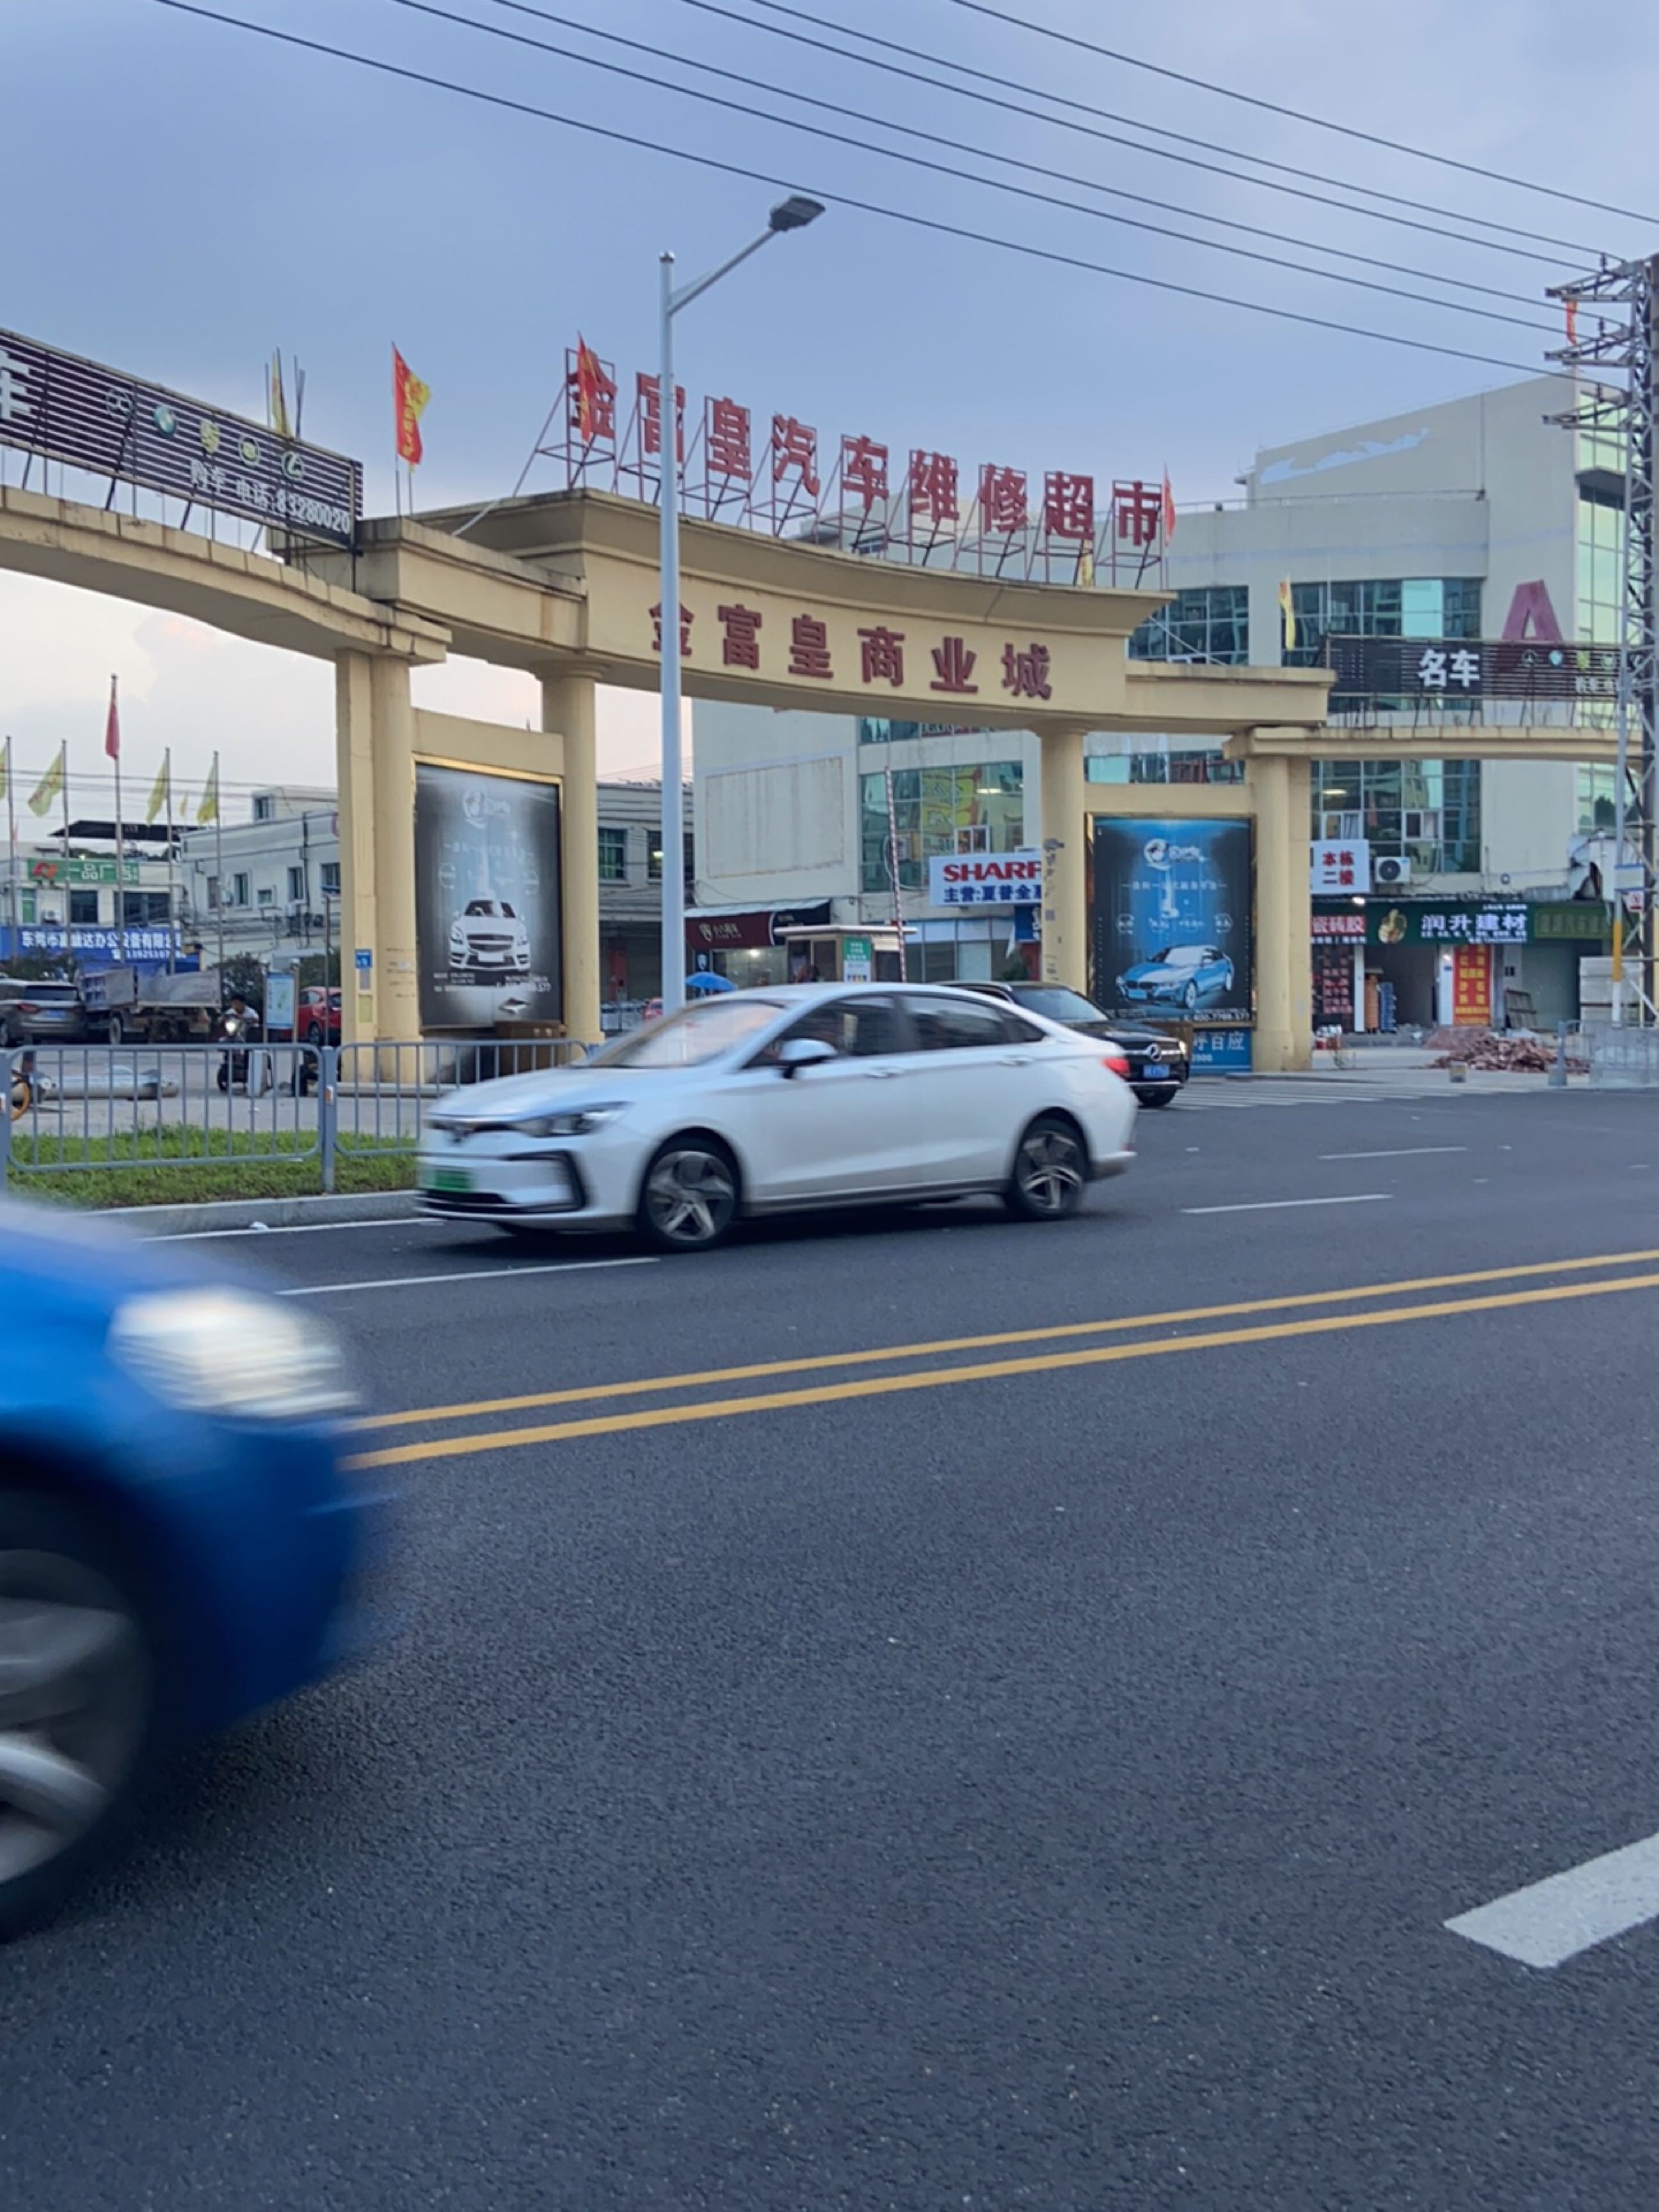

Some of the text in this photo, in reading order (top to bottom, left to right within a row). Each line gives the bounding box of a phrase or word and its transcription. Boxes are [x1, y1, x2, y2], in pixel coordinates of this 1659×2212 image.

[568, 348, 1162, 547] 金富皇汽车维修超市
[649, 602, 1053, 701] 金富皇商业城
[1417, 649, 1480, 687] 名车
[1421, 913, 1528, 931] 润升建材
